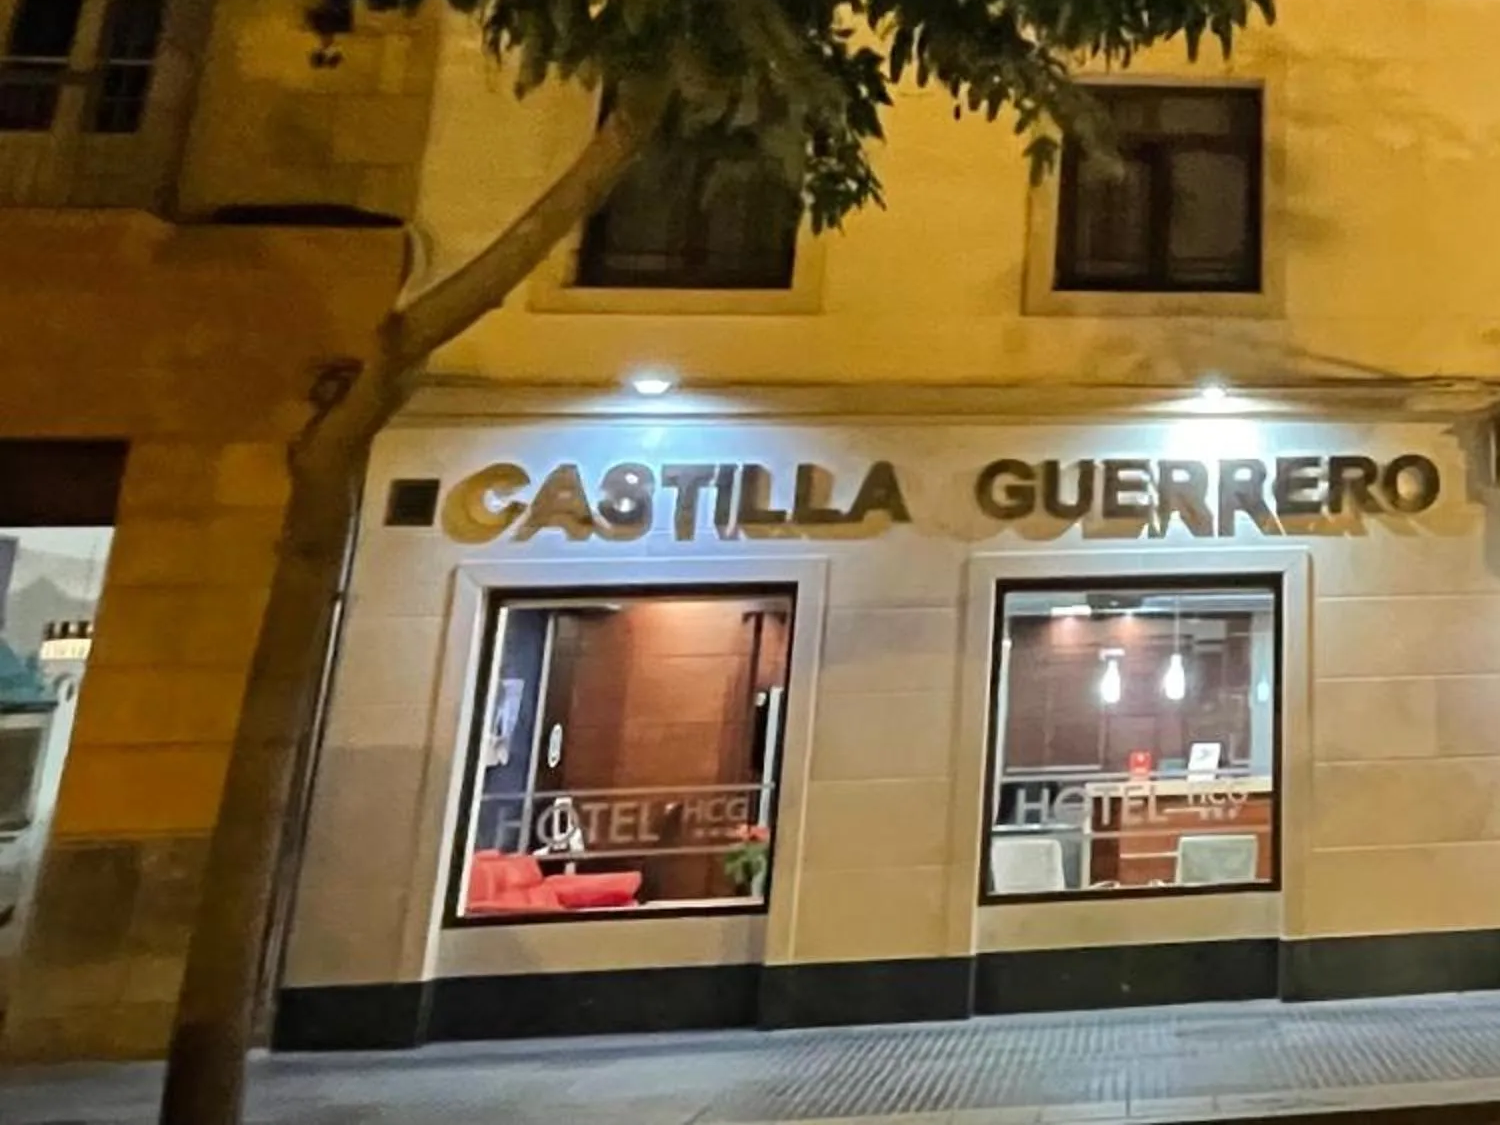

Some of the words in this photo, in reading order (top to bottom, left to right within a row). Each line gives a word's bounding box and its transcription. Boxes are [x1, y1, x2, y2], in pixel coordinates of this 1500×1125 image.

[446, 461, 912, 533] CASTILLA
[974, 453, 1441, 523] GUERRERO
[496, 801, 660, 850] HOTEL
[683, 796, 749, 823] HCG
[1015, 782, 1168, 825] HOTEL
